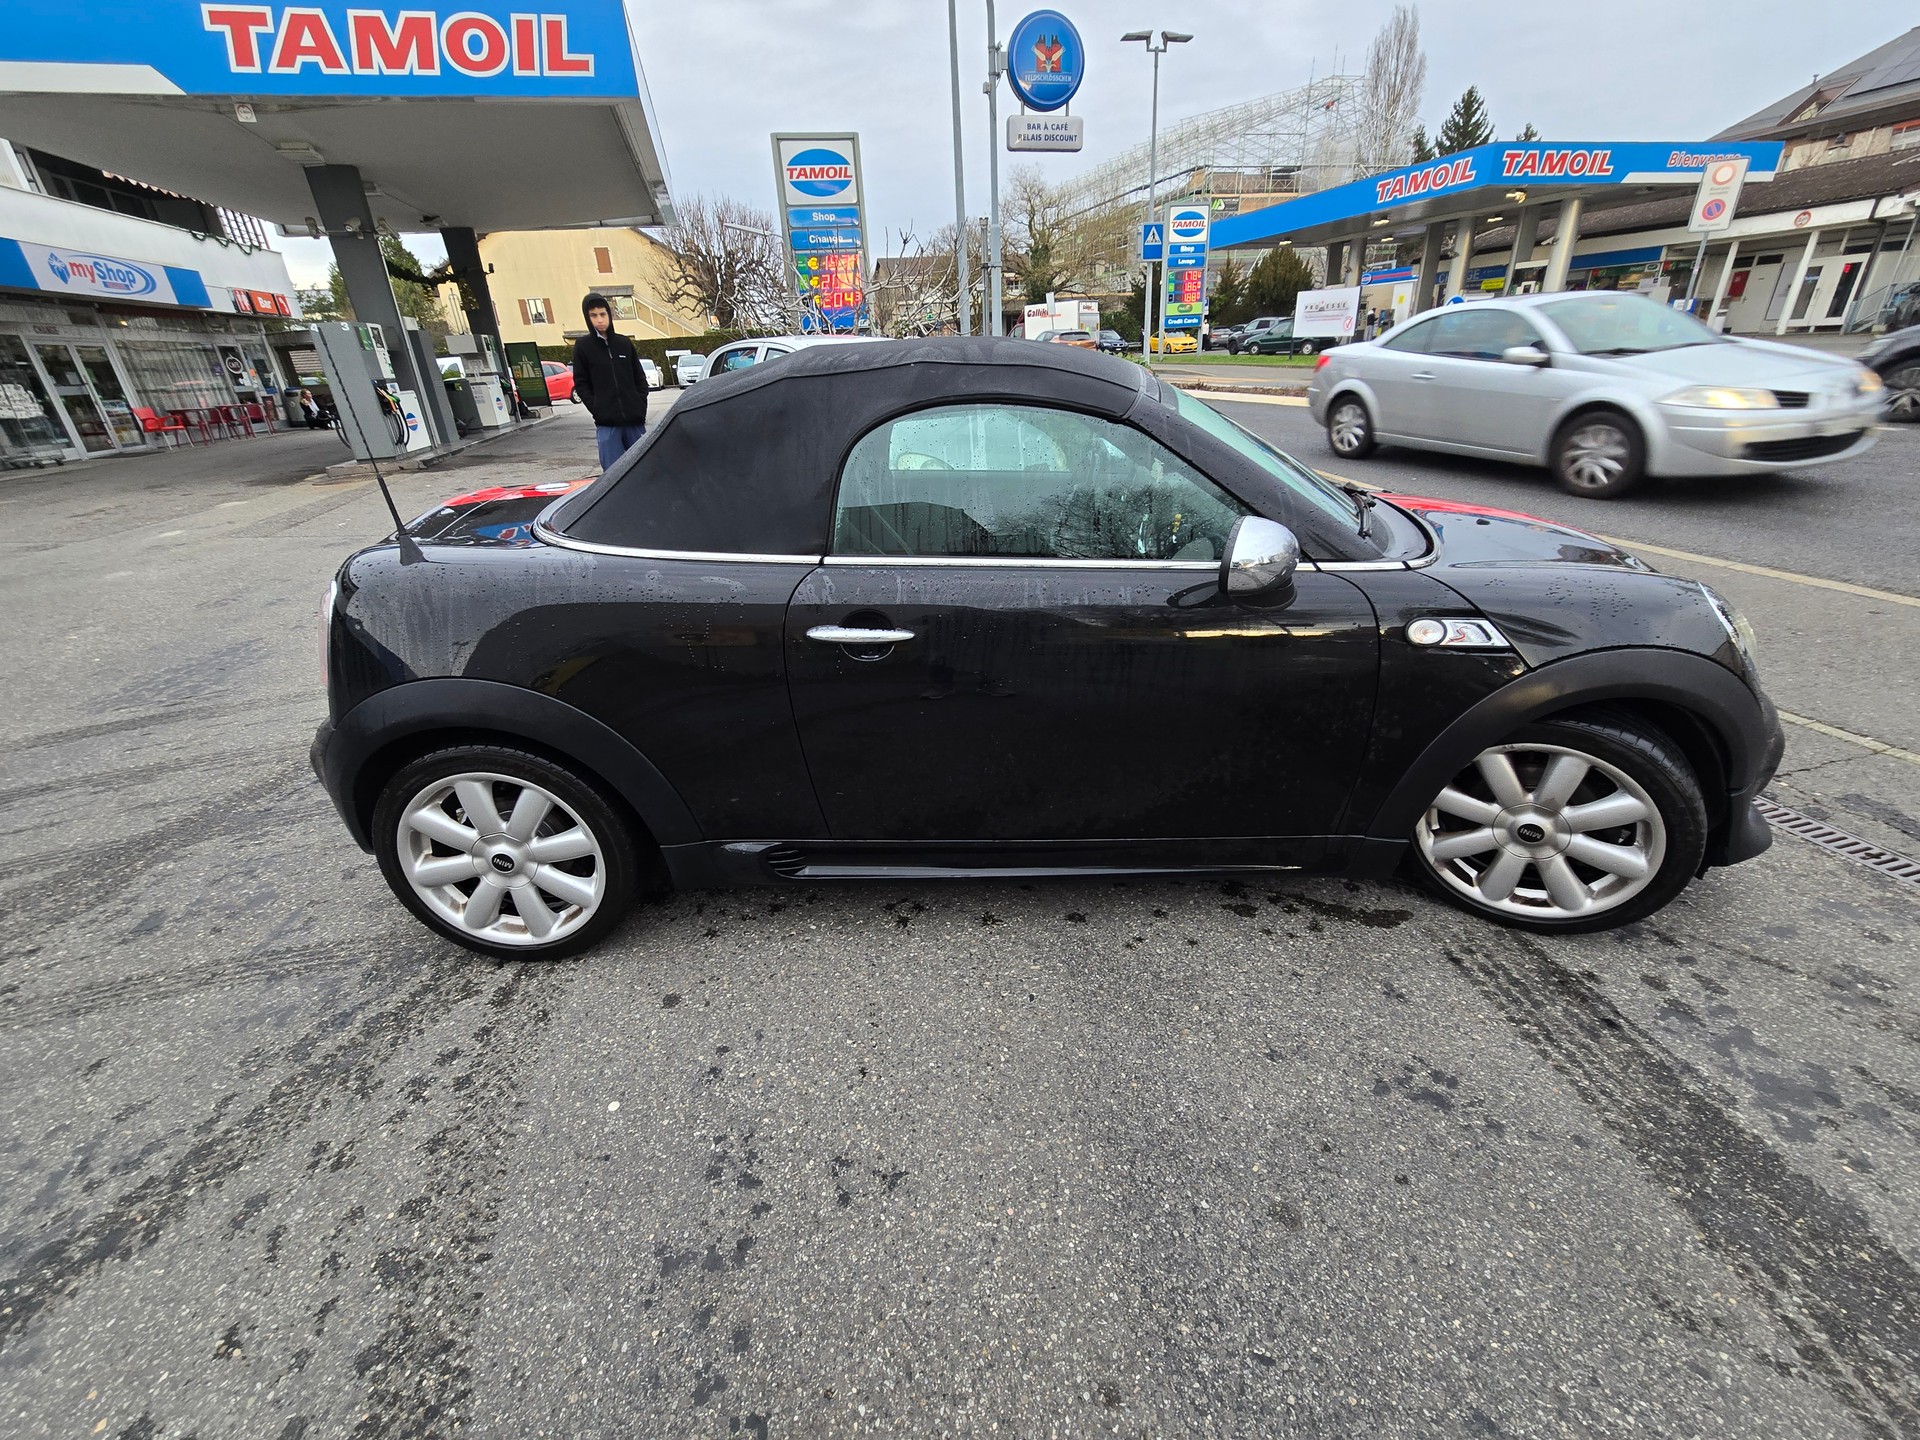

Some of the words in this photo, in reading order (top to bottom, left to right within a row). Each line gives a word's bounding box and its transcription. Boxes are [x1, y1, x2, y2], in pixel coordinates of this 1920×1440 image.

[201, 3, 595, 77] TAMOIL
[1043, 121, 1049, 130] À
[1051, 121, 1068, 131] CAFÉ
[1018, 133, 1042, 141] RELAIS
[1044, 134, 1077, 142] DISCOUNT
[1503, 150, 1614, 176] TAMOIL
[786, 166, 853, 180] TAMOIL
[1376, 156, 1477, 204] TAMOIL
[812, 212, 836, 222] Shop
[1172, 220, 1206, 228] TAMOIL
[1180, 245, 1195, 253] Shop
[68, 260, 137, 291] myShop
[257, 296, 272, 309] Bar
[310, 323, 319, 332] 4
[340, 322, 350, 331] 3
[1520, 827, 1543, 839] MINI
